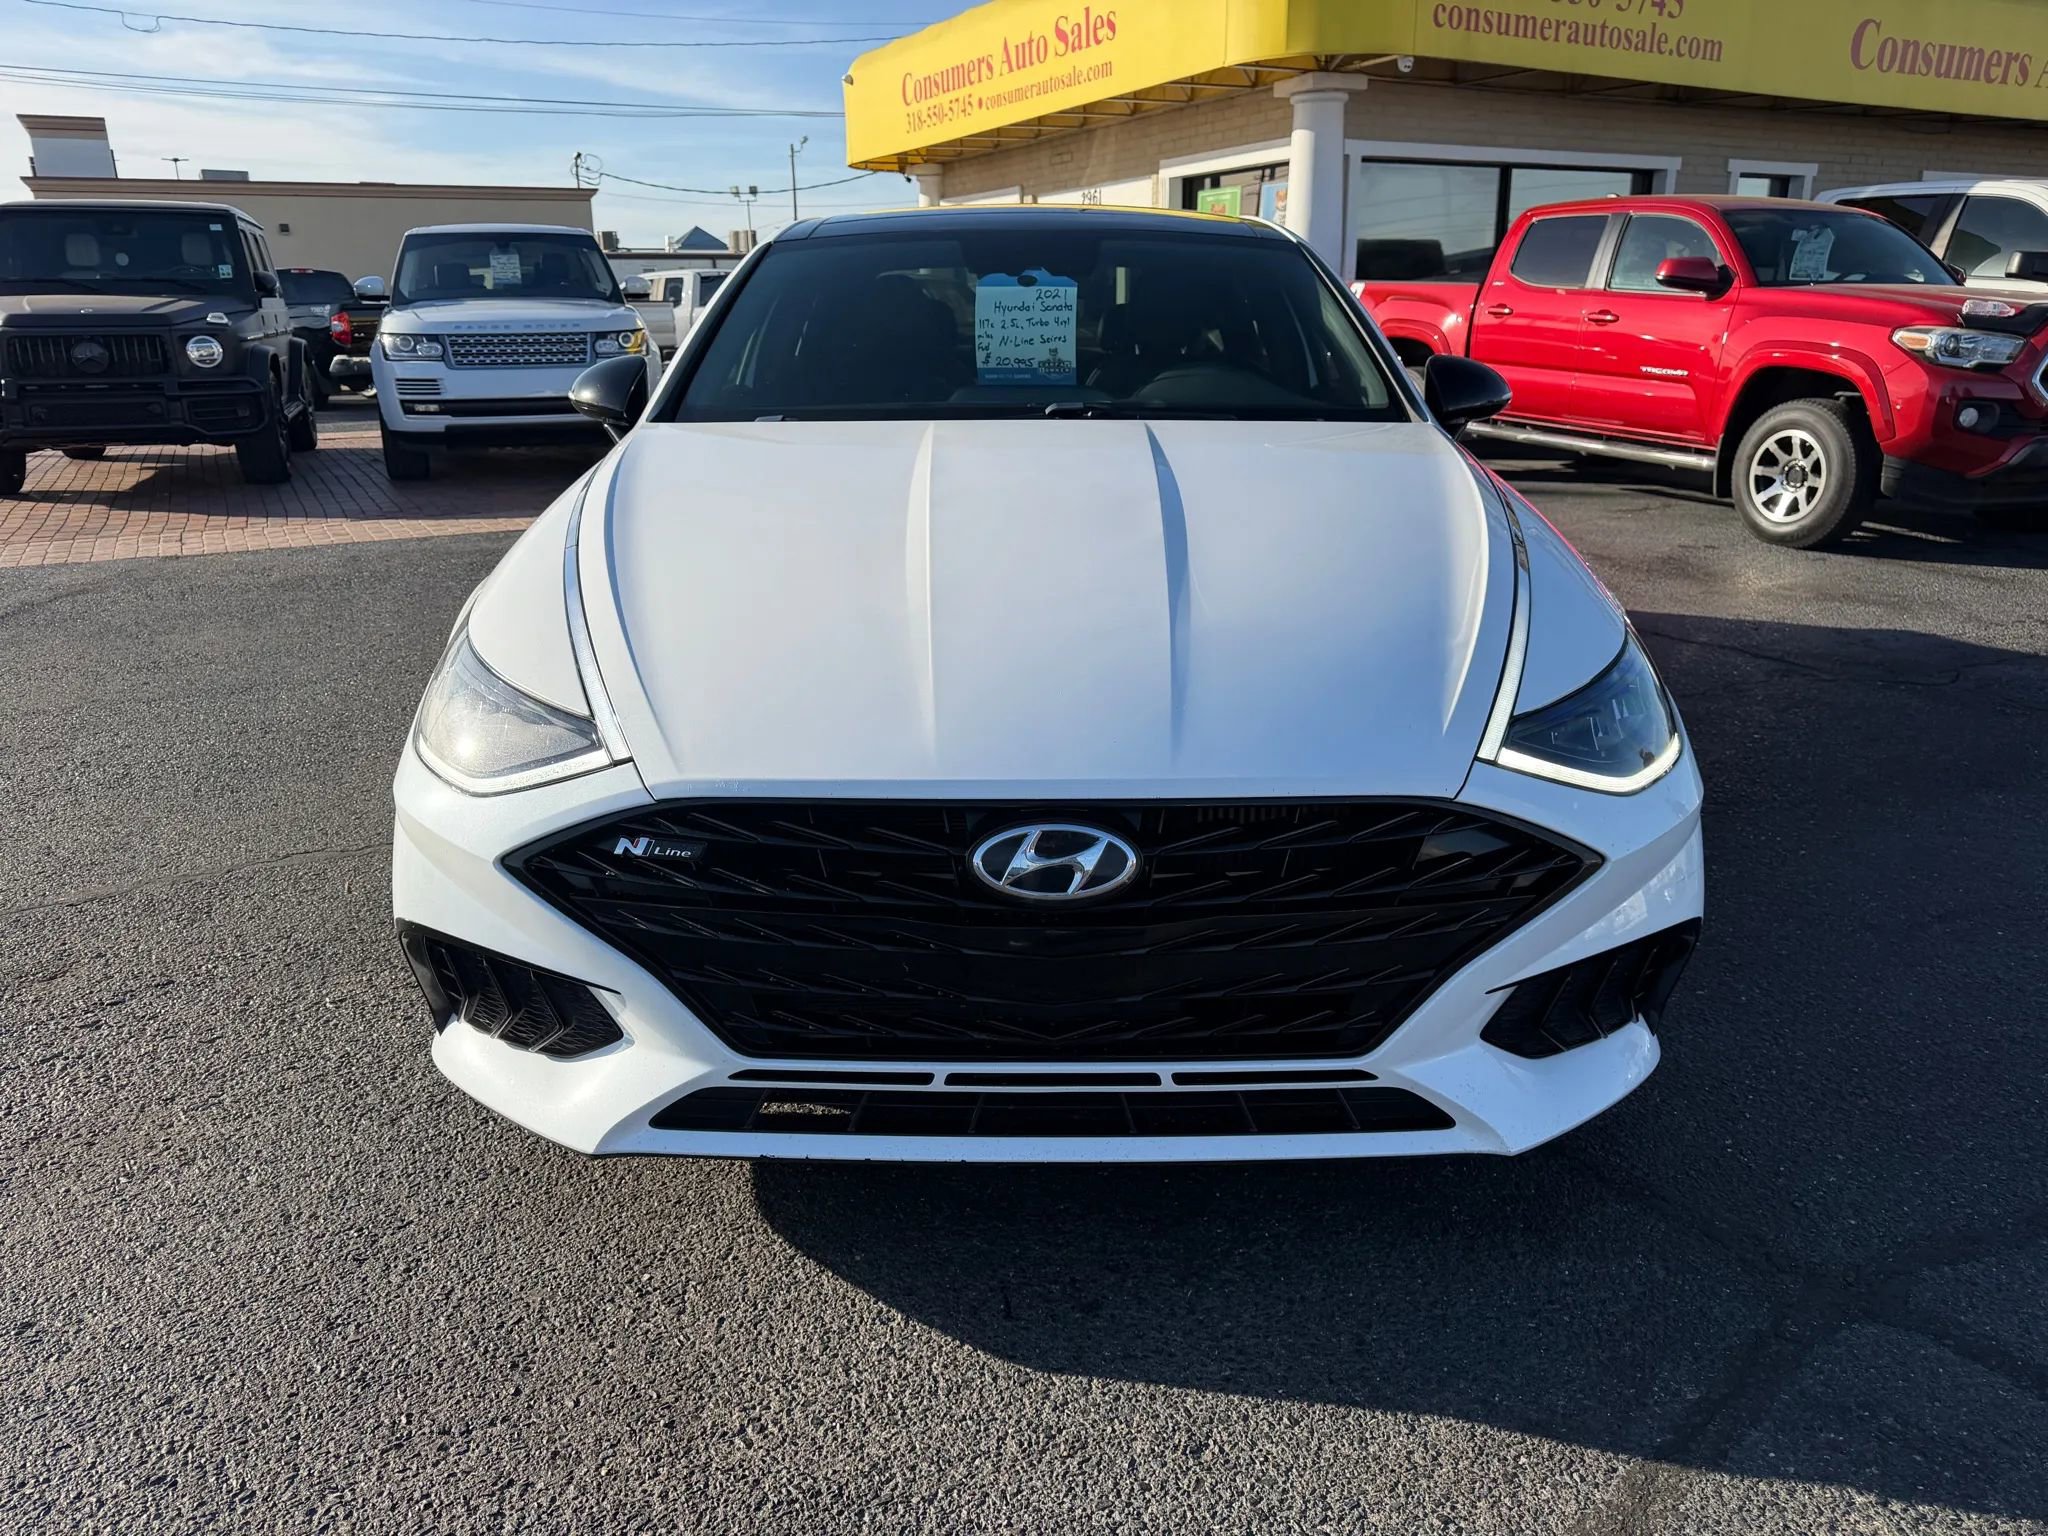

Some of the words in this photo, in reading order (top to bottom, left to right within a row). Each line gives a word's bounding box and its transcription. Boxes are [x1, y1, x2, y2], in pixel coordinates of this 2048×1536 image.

[1433, 2, 1723, 62] consumerautosale.com
[902, 54, 993, 107] Consumers
[1000, 32, 1048, 76] Auto
[1055, 6, 1117, 57] Sales
[1851, 18, 2033, 87] Consumers
[906, 93, 974, 134] 318-550-5745
[985, 60, 1113, 111] consumerautosale.com
[994, 301, 1035, 316] Hyundai
[1040, 301, 1073, 312] Sonata
[1035, 288, 1067, 301] 2021
[1025, 317, 1050, 328] Turbo
[654, 847, 692, 858] Line
